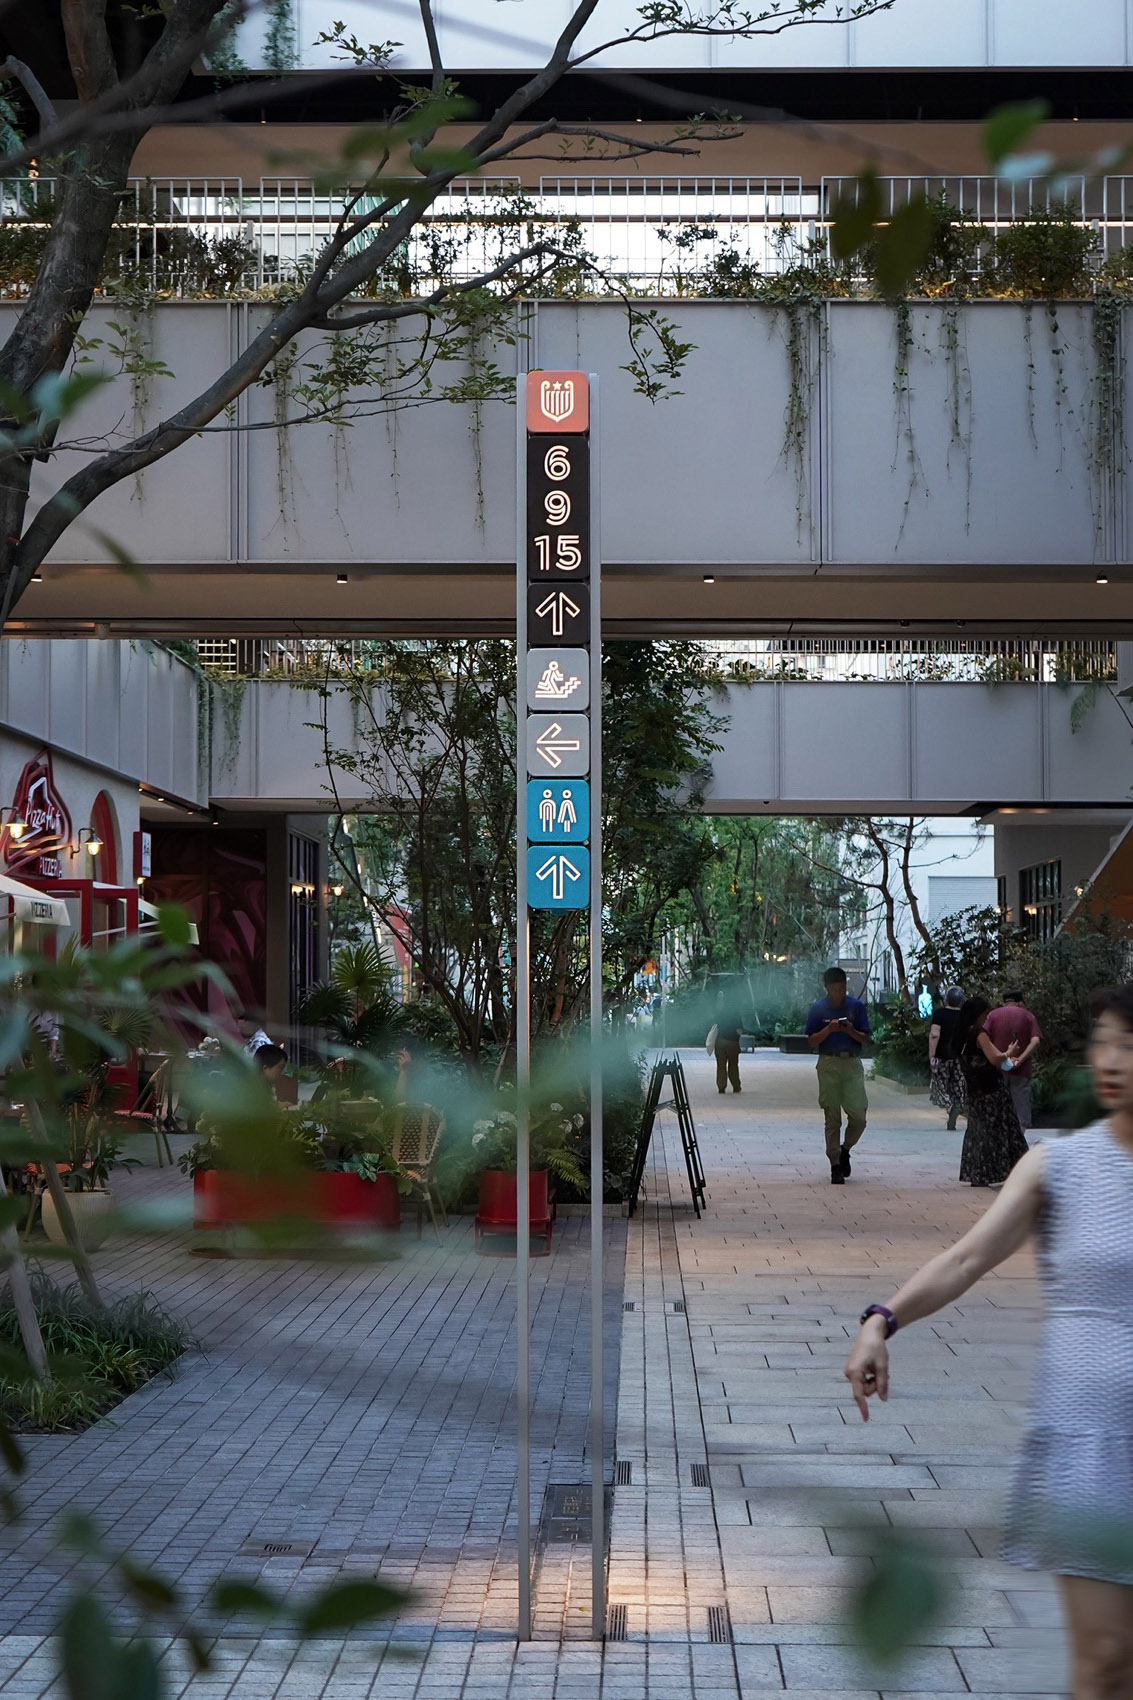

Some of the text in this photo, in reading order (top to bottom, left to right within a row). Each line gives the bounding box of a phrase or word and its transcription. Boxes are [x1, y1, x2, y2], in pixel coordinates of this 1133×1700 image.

[544, 445, 571, 481] 6
[544, 490, 571, 526] 9
[534, 535, 582, 571] 15
[25, 801, 61, 832] Pizza Hut
[39, 855, 63, 878] PIZZERIA
